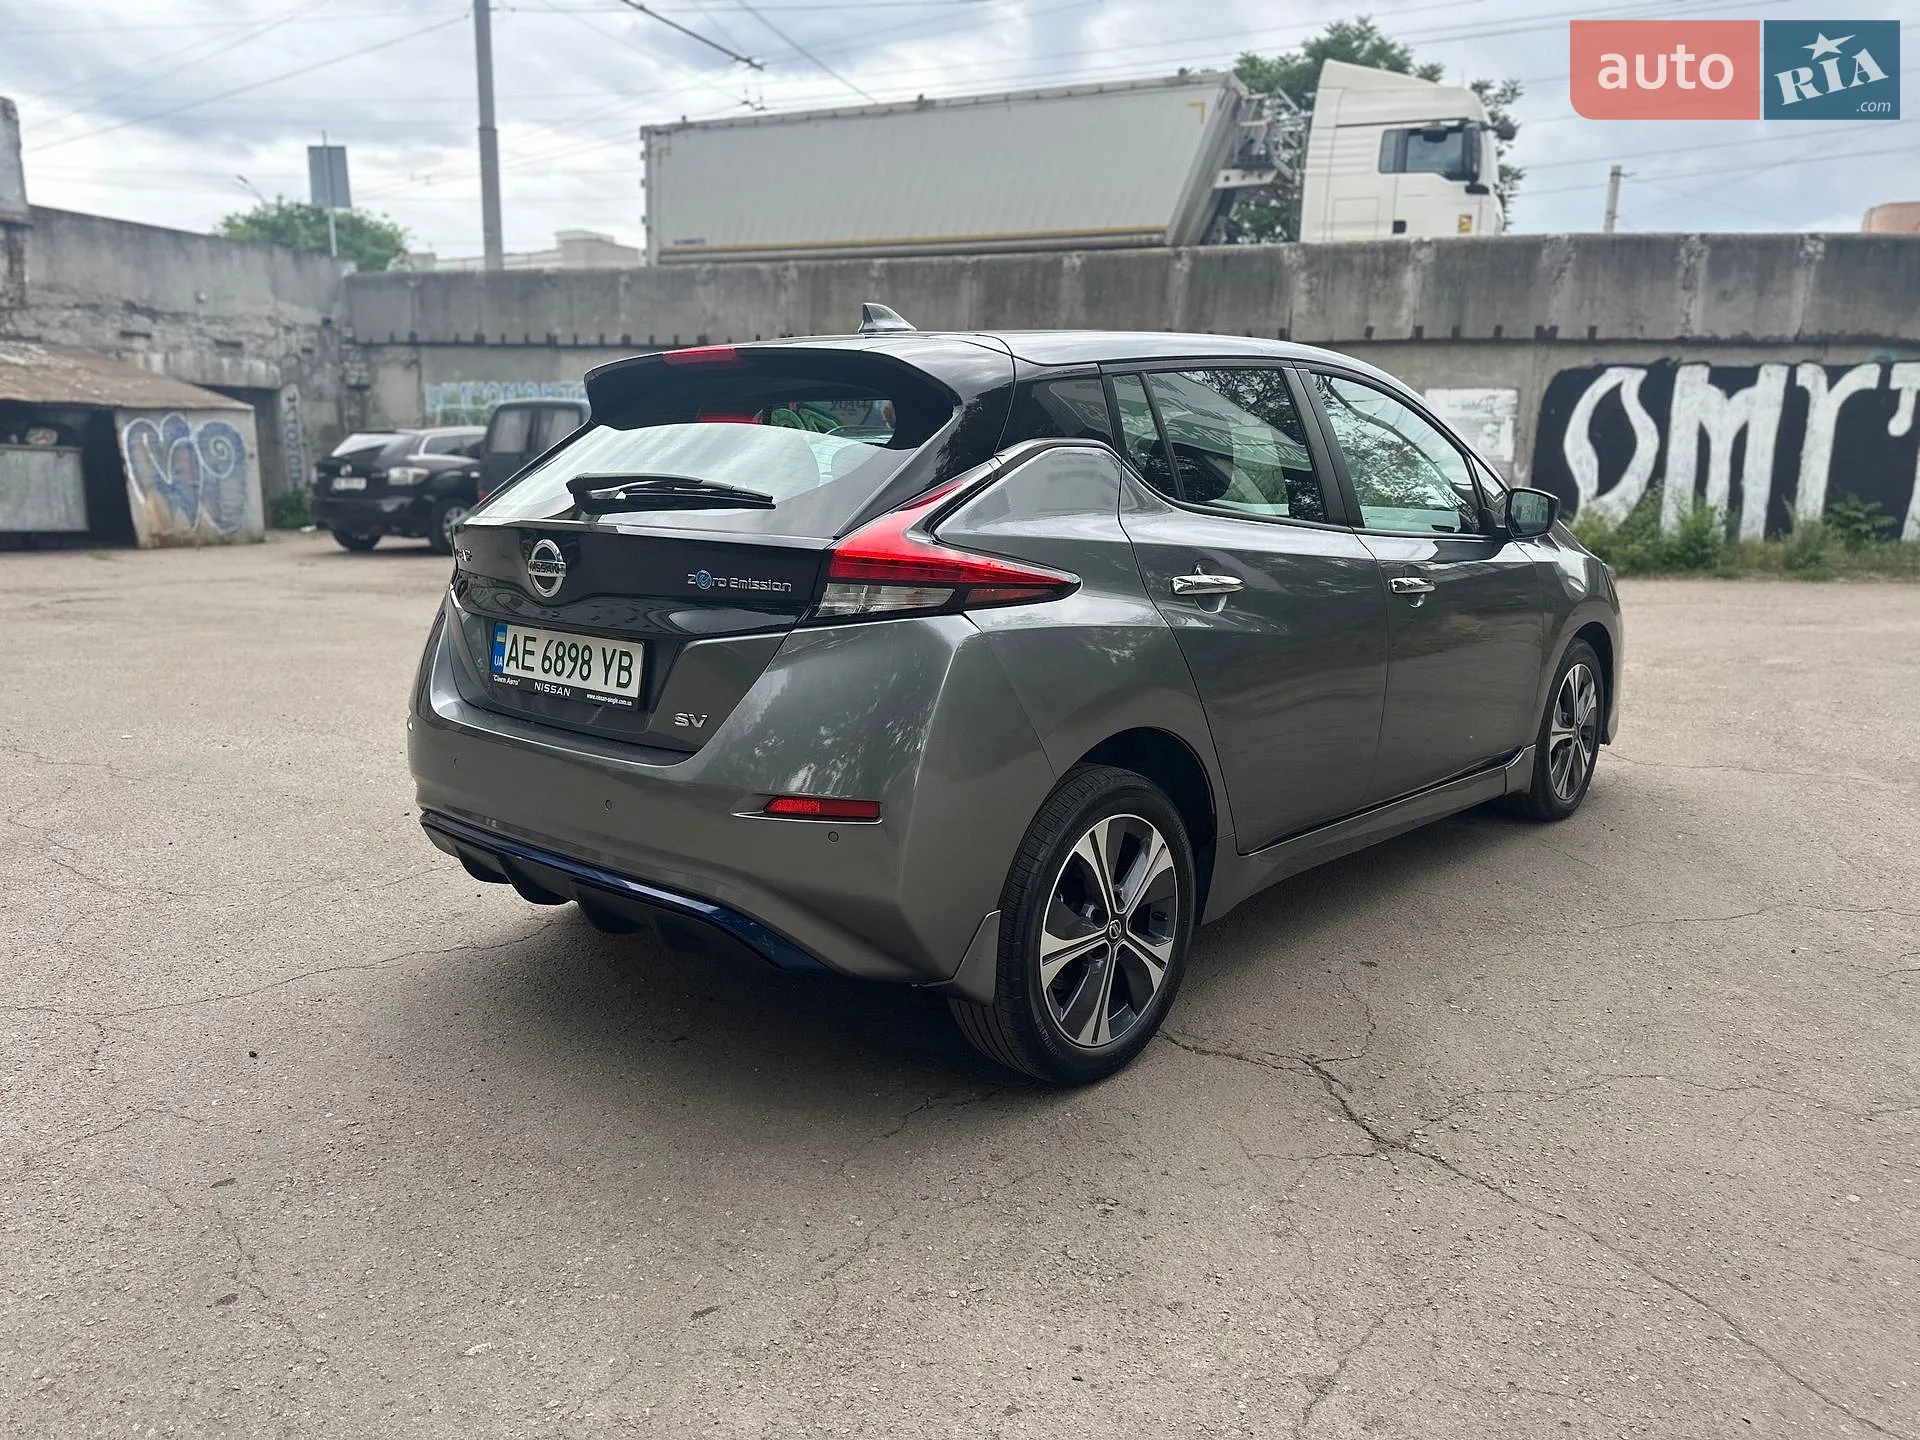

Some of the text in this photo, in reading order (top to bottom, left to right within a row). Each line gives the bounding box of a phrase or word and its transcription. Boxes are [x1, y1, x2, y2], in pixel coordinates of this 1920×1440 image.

[729, 577, 792, 592] Emission
[494, 655, 504, 667] UA
[505, 633, 634, 689] AE 6898 YB
[534, 681, 571, 697] NISSAN
[674, 713, 708, 728] SV
